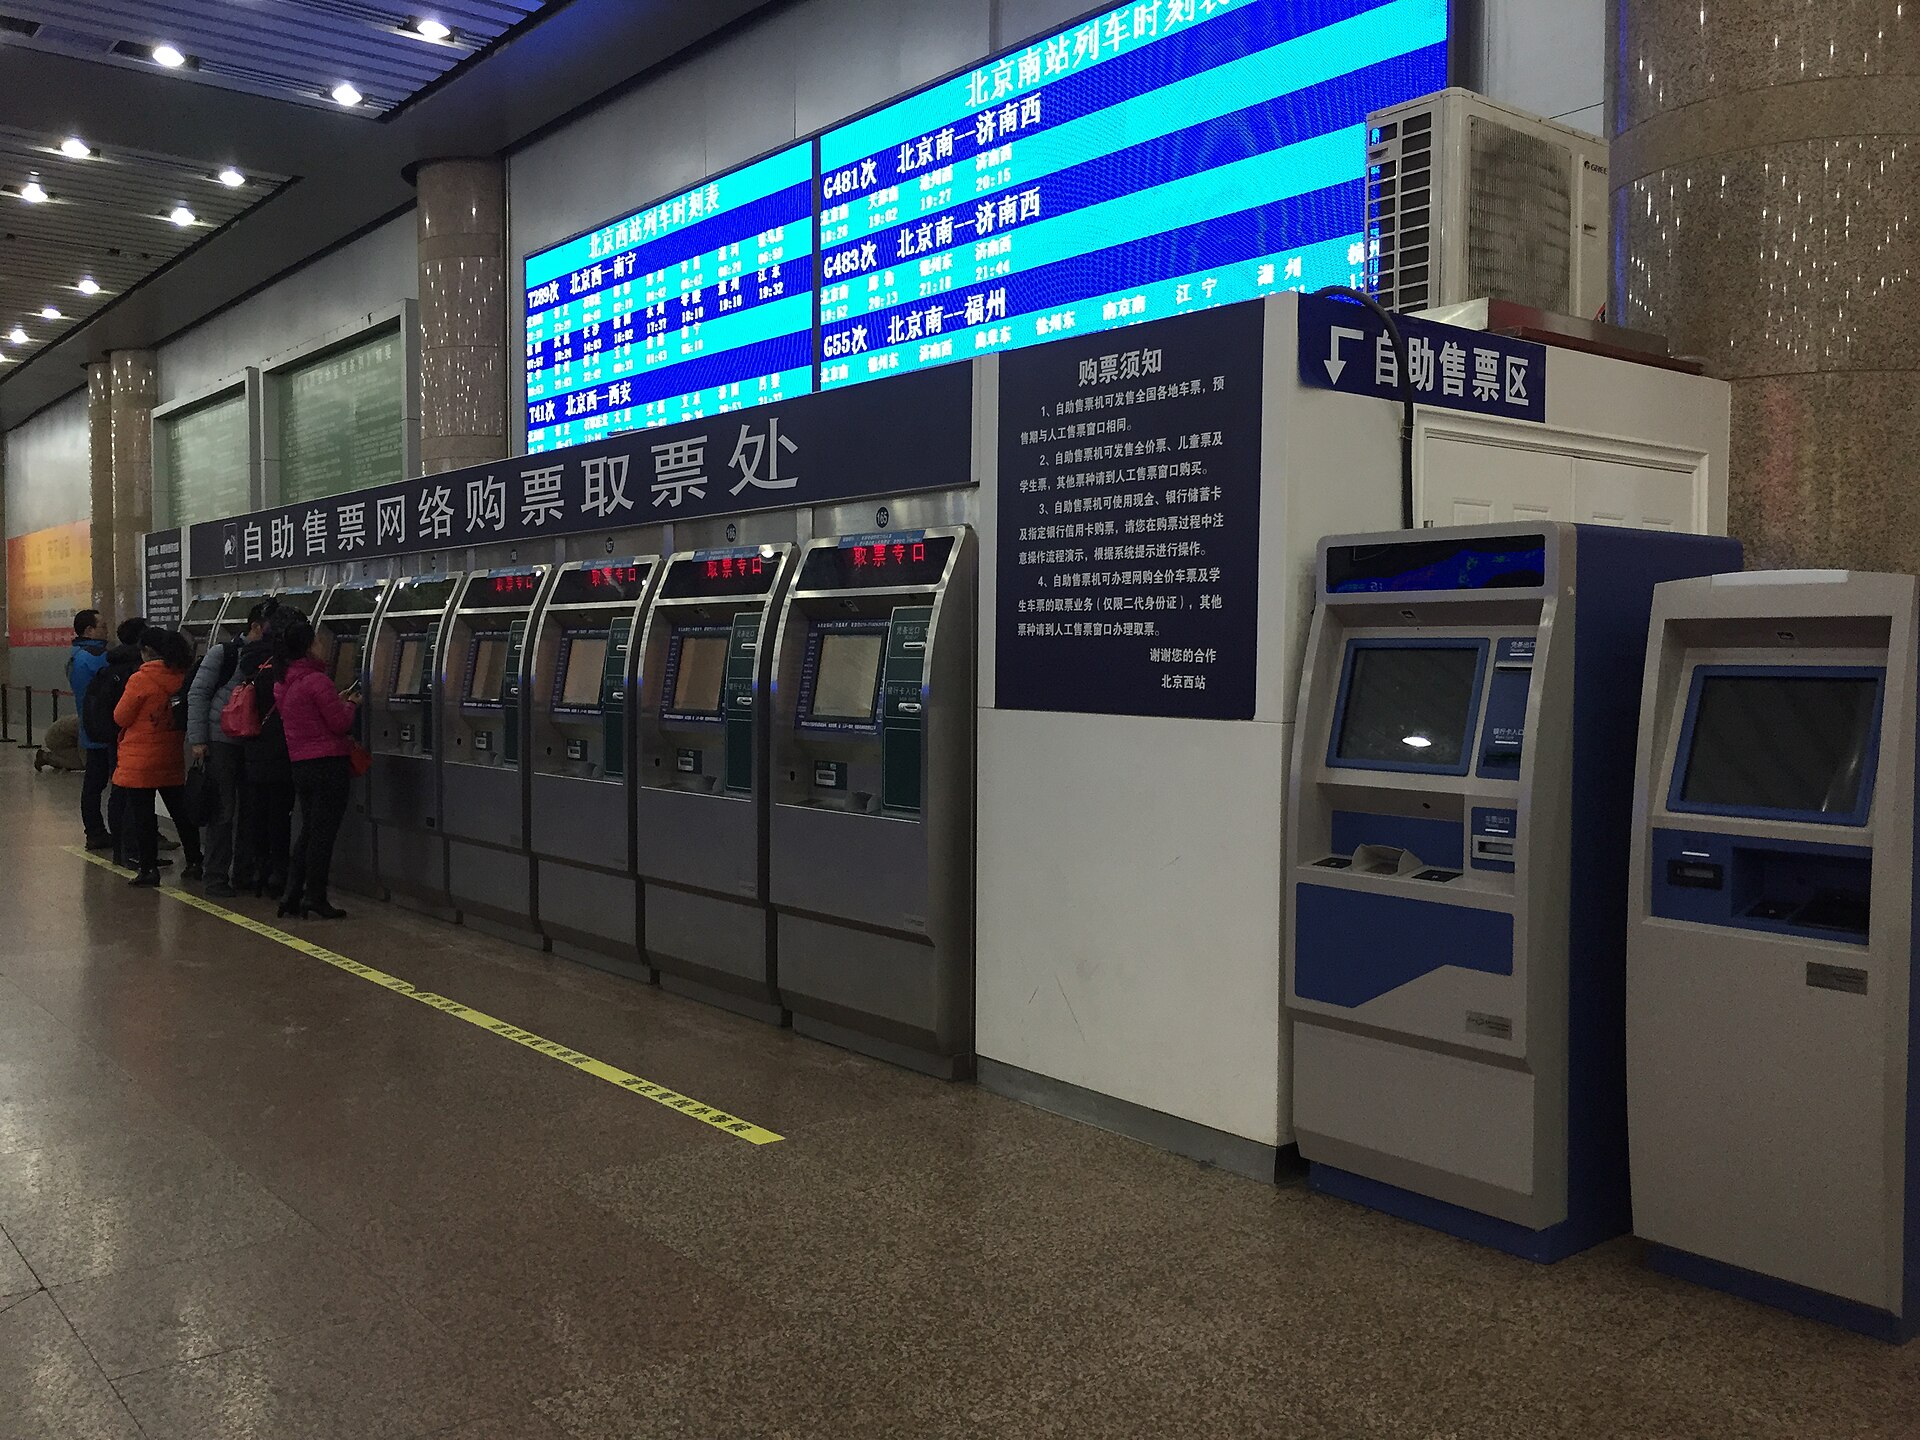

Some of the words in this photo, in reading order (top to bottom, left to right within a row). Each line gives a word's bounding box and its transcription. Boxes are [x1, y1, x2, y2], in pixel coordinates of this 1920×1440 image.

[824, 158, 877, 200] G481次
[588, 182, 720, 259] 北京西站列车时刻表
[824, 240, 877, 279] G483次
[824, 324, 868, 357] G55次
[1078, 348, 1163, 387] 购票须知
[1375, 329, 1529, 407] 自助售票区
[242, 418, 801, 564] 自助售票网络购票取票处
[853, 542, 926, 568] 取票专口
[1149, 647, 1217, 664] 谢谢您的合作
[1161, 674, 1206, 690] 北京西站
